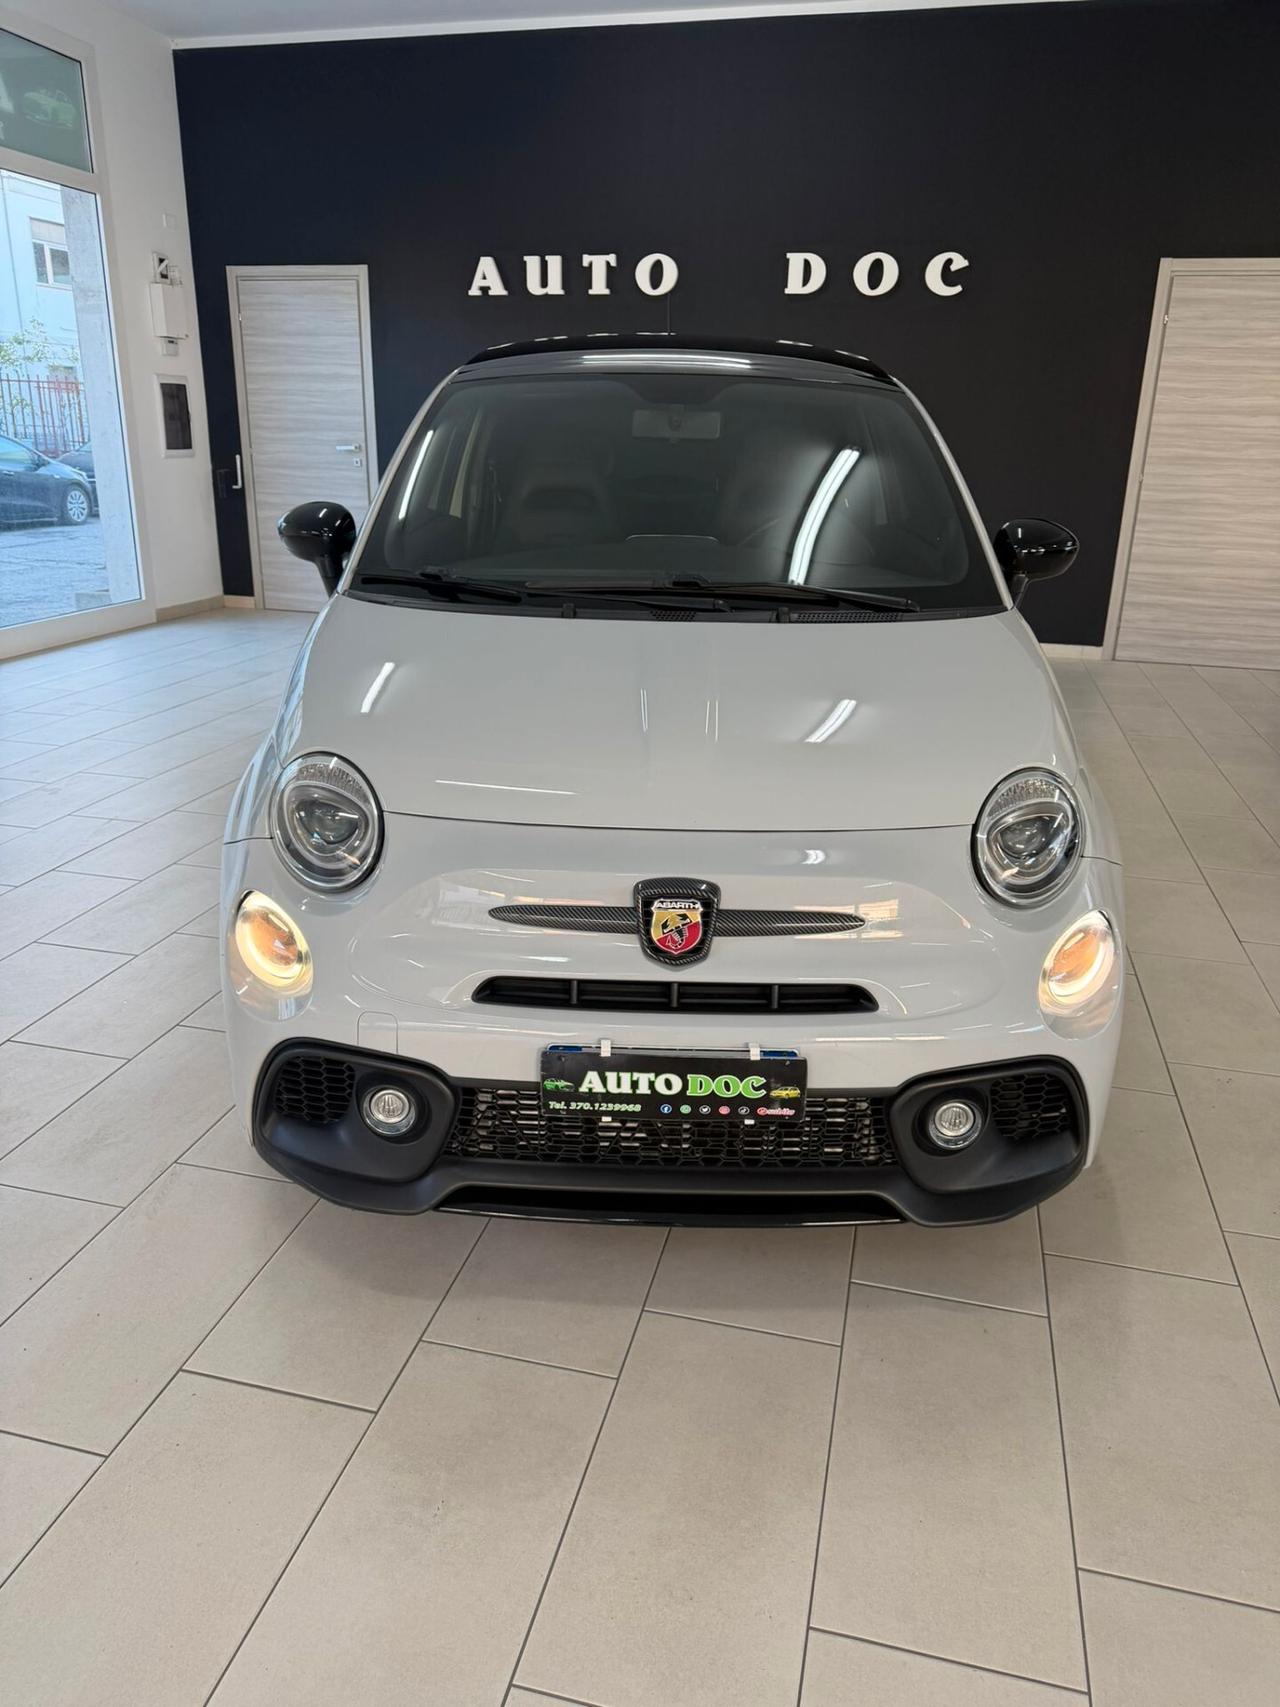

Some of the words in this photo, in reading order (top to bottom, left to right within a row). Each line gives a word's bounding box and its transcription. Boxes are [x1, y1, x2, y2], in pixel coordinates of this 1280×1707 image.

[468, 252, 679, 297] AUTO
[784, 251, 970, 297] DOC
[655, 901, 699, 910] ABARTH
[579, 1070, 683, 1096] AUTO
[686, 1073, 767, 1099] DOC
[548, 1100, 568, 1110] Tel.
